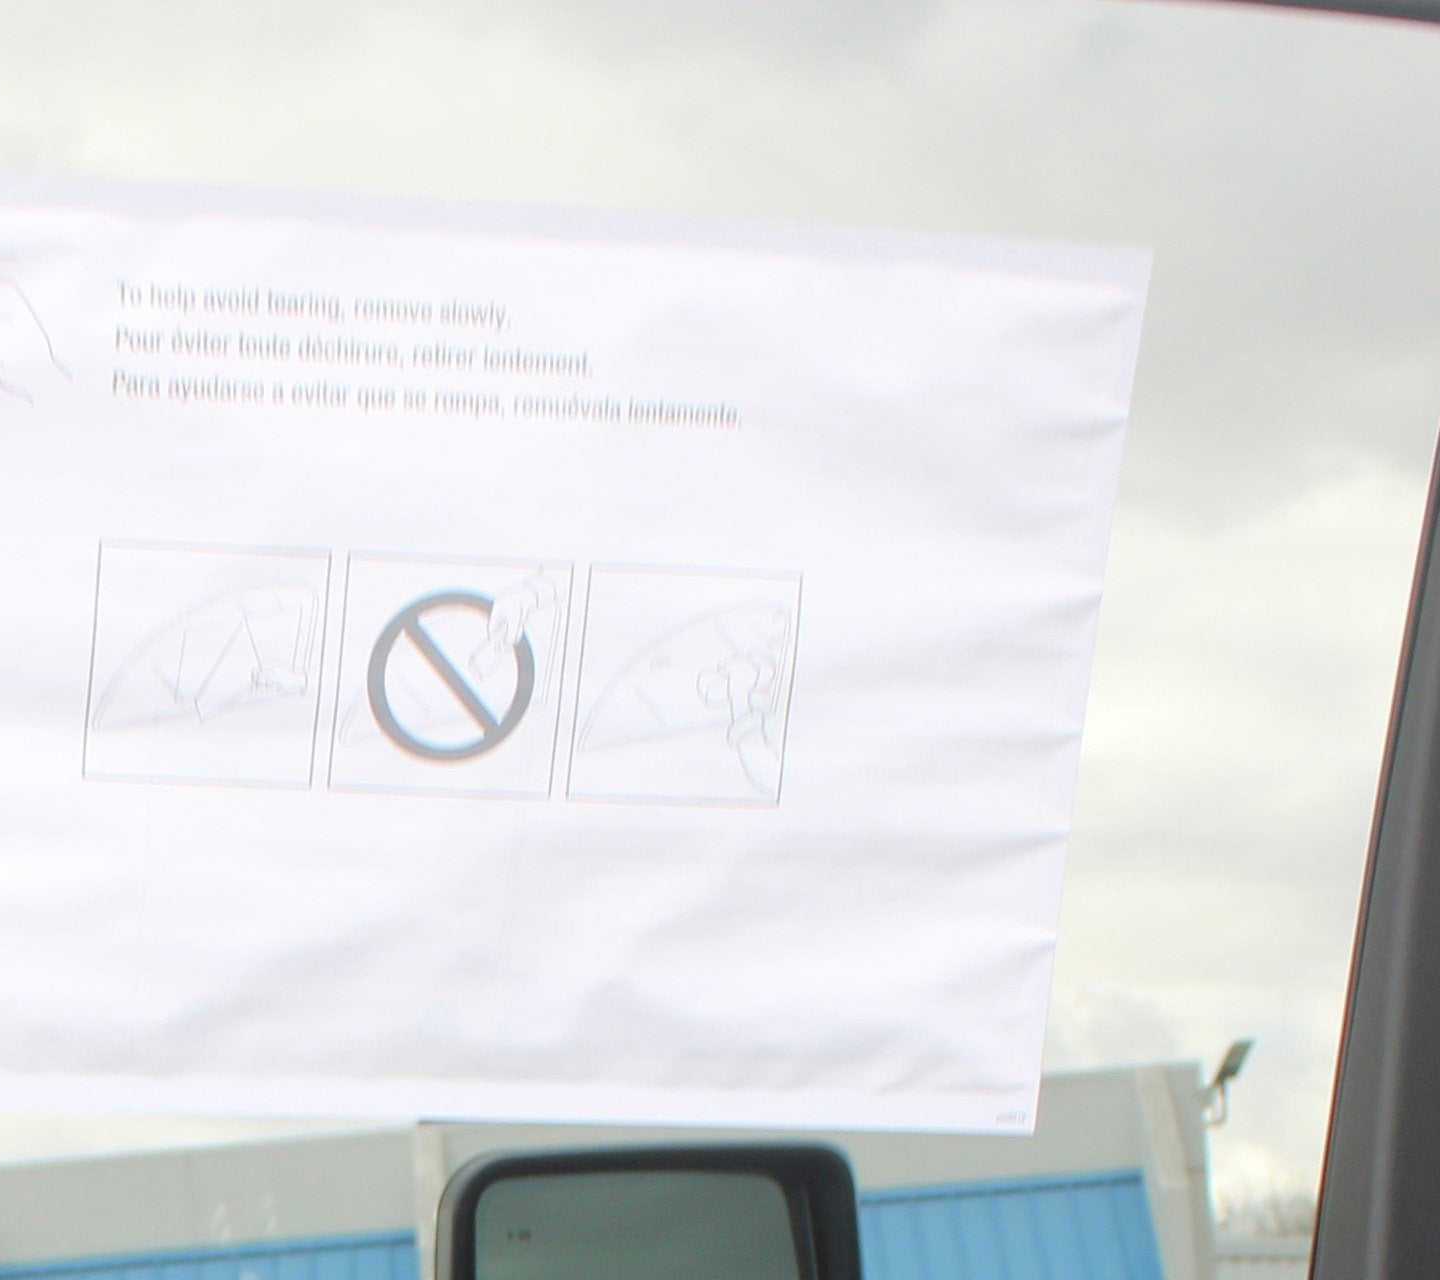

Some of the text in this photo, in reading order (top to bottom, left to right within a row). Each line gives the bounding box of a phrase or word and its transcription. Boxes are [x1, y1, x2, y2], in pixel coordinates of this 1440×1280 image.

[117, 277, 511, 336] To help avoid tearing, remove slowly.
[115, 323, 163, 356] Pour
[171, 325, 231, 359] éviter
[238, 331, 292, 361] toute
[413, 340, 476, 371] retirer
[483, 342, 593, 380] lentement.
[112, 367, 161, 400] Para
[167, 372, 265, 406] ayudarse
[271, 381, 285, 406] a
[291, 378, 351, 410] evitar
[356, 384, 396, 416] que
[402, 386, 427, 413] se
[434, 389, 506, 421] rompa,
